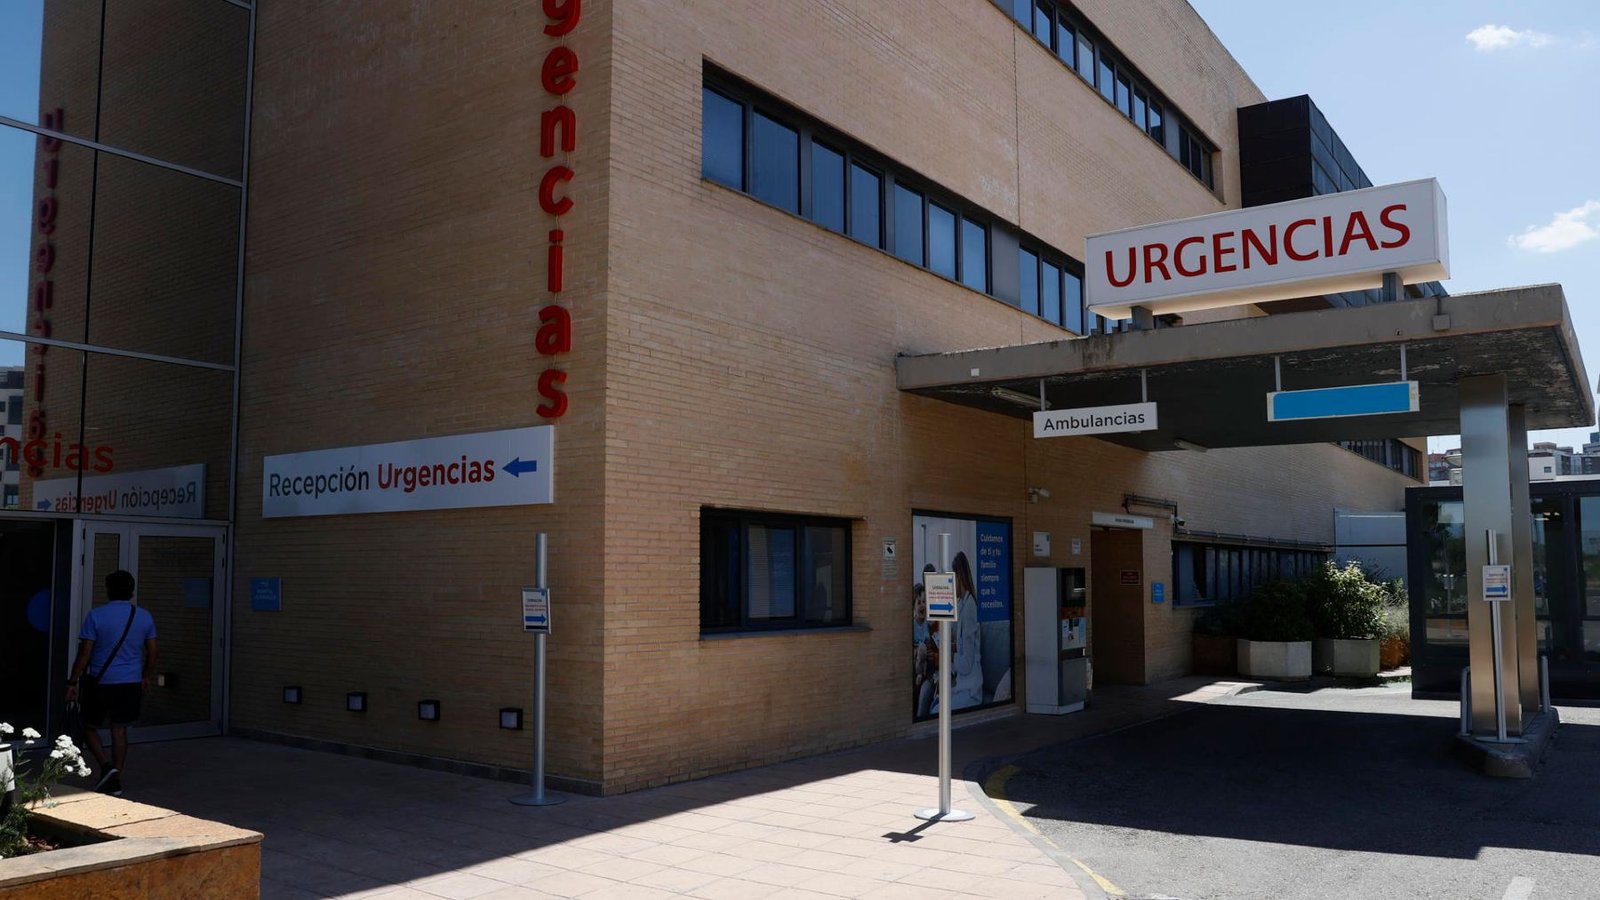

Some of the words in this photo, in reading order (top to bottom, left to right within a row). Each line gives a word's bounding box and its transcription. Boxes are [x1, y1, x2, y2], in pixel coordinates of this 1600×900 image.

[1105, 204, 1411, 288] URGENCIAS
[1043, 412, 1145, 431] Ambulancias
[269, 465, 369, 499] Recepción
[378, 455, 495, 493] Urgencias
